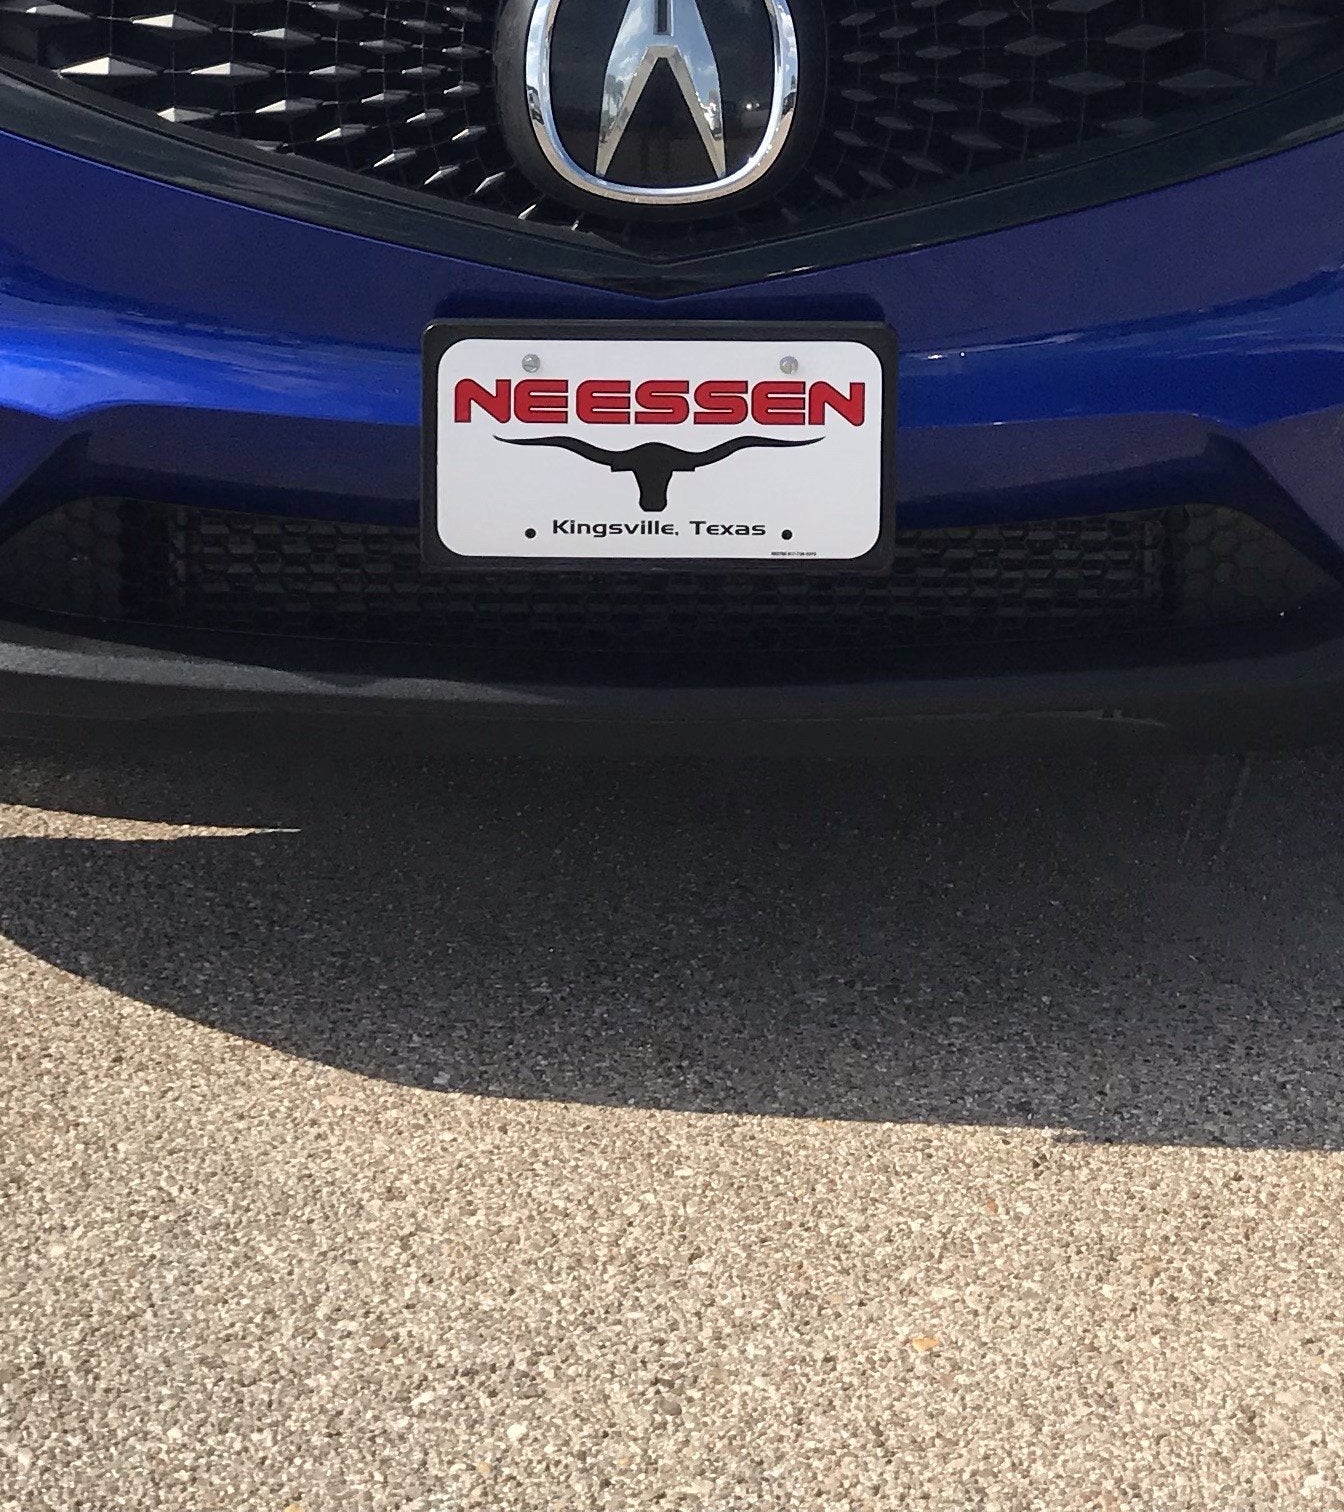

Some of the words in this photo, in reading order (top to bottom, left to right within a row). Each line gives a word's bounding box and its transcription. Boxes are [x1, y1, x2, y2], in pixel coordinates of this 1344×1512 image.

[454, 378, 865, 427] NEESSEN
[552, 519, 680, 538] Kingsville,
[688, 520, 766, 536] Texas
